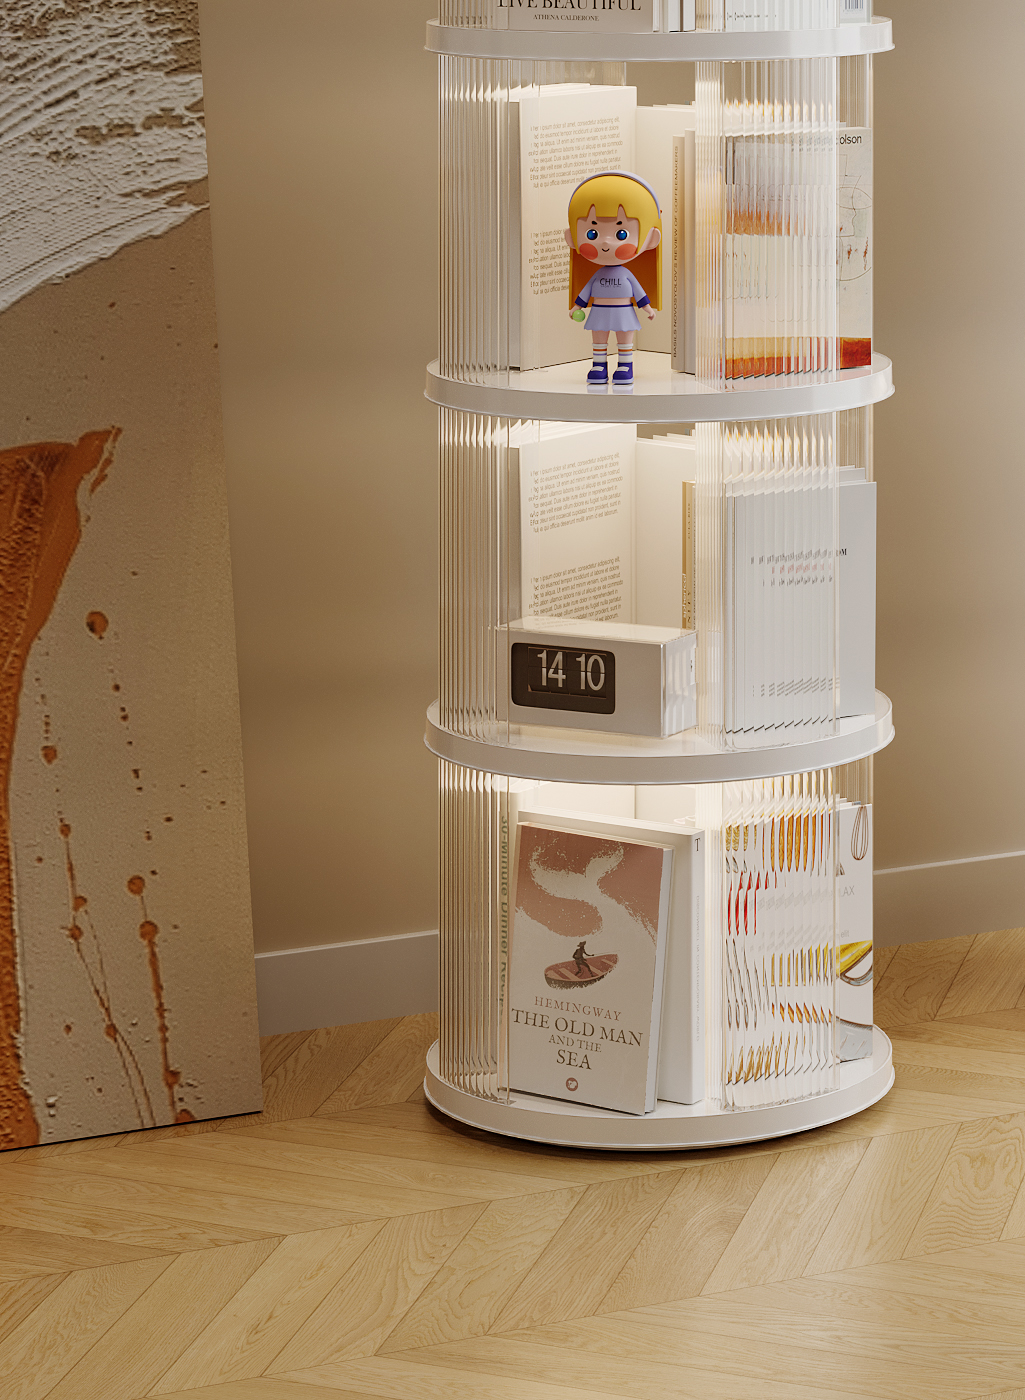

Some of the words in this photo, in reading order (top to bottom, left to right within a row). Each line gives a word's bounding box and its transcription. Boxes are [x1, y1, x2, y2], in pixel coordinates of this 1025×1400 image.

[560, 14, 600, 22] CALDERONE
[836, 134, 862, 144] olson
[600, 278, 622, 286] CHILL
[537, 649, 566, 688] 14
[576, 653, 606, 691] 10
[534, 996, 622, 1021] HEMINGWAY
[511, 1008, 550, 1029] THE
[555, 1017, 595, 1037] OLD
[599, 1026, 643, 1046] MAN
[548, 1034, 574, 1047] AND
[576, 1039, 602, 1052] THE
[556, 1049, 592, 1070] SEA
